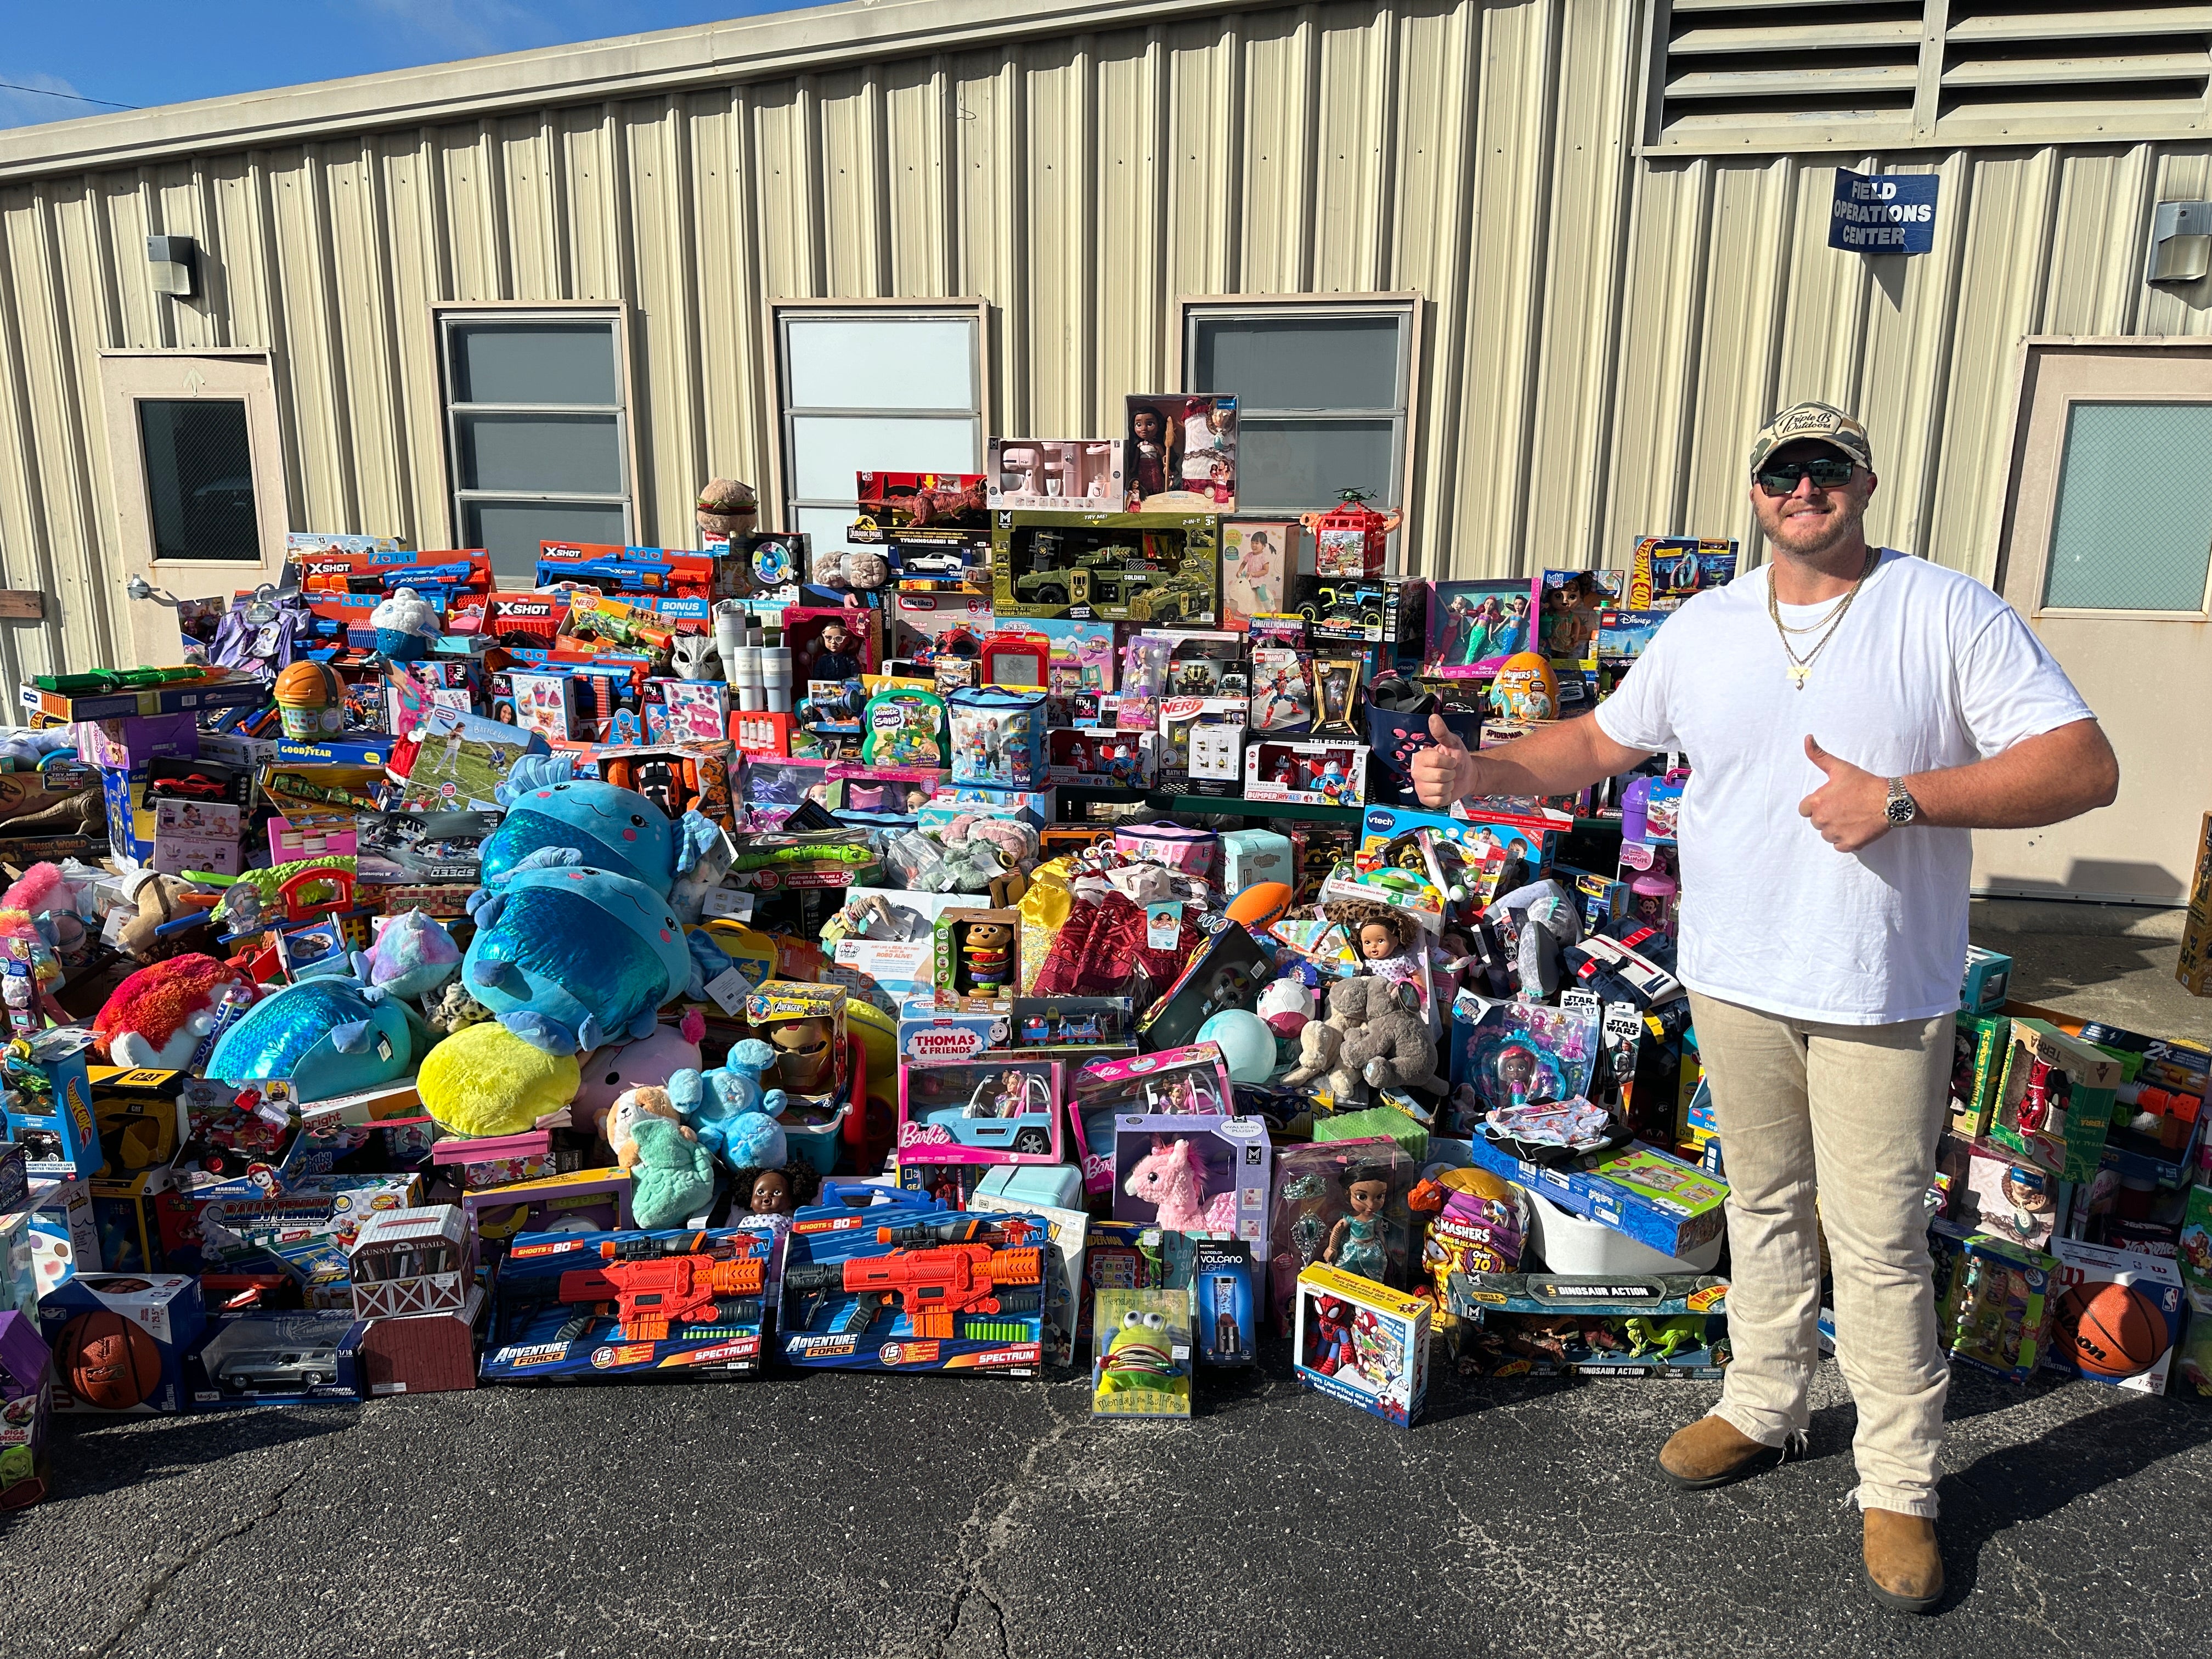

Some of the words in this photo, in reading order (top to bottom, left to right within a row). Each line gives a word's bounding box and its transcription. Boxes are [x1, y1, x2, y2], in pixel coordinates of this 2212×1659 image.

[1852, 180, 1896, 200] FIELD
[1834, 200, 1931, 223] OPERATIONS
[1843, 225, 1905, 245] CENTER
[1780, 410, 1816, 433] Triple
[1817, 412, 1832, 423] B
[1786, 421, 1831, 432] Outdoors
[662, 602, 699, 611] BONUS
[967, 599, 979, 613] 6
[1267, 654, 1285, 662] MARVEL
[1160, 699, 1204, 716] NERF
[1486, 729, 1524, 740] SPIDER-MAN
[1247, 791, 1278, 800] BUMPER
[1278, 792, 1301, 802] RIVALS
[1368, 815, 1395, 826] vtech
[22, 842, 55, 851] JURASSIC
[56, 840, 87, 849] WORLD
[391, 899, 432, 910] TURTLES
[774, 1000, 804, 1013] AVENGERS
[1584, 1007, 1595, 1015] 17
[1606, 1024, 1640, 1036] WARS
[1611, 1019, 1638, 1030] STAR
[915, 1035, 975, 1046] THOMAS
[919, 1046, 927, 1054] &
[929, 1046, 971, 1054] FRIENDS
[129, 1071, 165, 1082] CAT
[1075, 1068, 1122, 1083] Barbie
[303, 1112, 342, 1129] bright
[900, 1121, 951, 1148] Barbie
[307, 1151, 332, 1165] baby
[274, 1196, 332, 1221] TENNIS
[799, 1221, 828, 1231] SHOOTS
[832, 1218, 850, 1229] 80
[1434, 1215, 1491, 1243] SMASHERS
[362, 1246, 392, 1256] SUNNY
[413, 1240, 446, 1250] TRAILS
[518, 1246, 547, 1256] SHOOTS
[552, 1242, 571, 1253] 80
[1459, 1240, 1483, 1250] ISLAND
[1200, 1255, 1243, 1264] VOLCANO
[1472, 1250, 1492, 1260] Over
[1200, 1263, 1226, 1272] LIGHT
[1473, 1258, 1491, 1271] 70
[313, 1273, 339, 1284] CITY
[1333, 1273, 1359, 1287] Spidey
[1546, 1285, 1556, 1295] 5
[1558, 1286, 1609, 1296] DINOSAUR
[1611, 1287, 1649, 1296] ACTION
[1690, 1289, 1711, 1305] TRY
[786, 1333, 857, 1353] ADVENTURE
[493, 1341, 568, 1363] ADVENTURE
[596, 1350, 613, 1362] 15
[694, 1344, 753, 1361] SPECTRUM
[810, 1345, 851, 1356] FORCE
[884, 1345, 899, 1358] 15
[517, 1353, 561, 1366] FORCE
[979, 1351, 1035, 1364] SPECTRUM
[1579, 1366, 1615, 1375] DINOSAUR
[1616, 1367, 1645, 1376] ACTION
